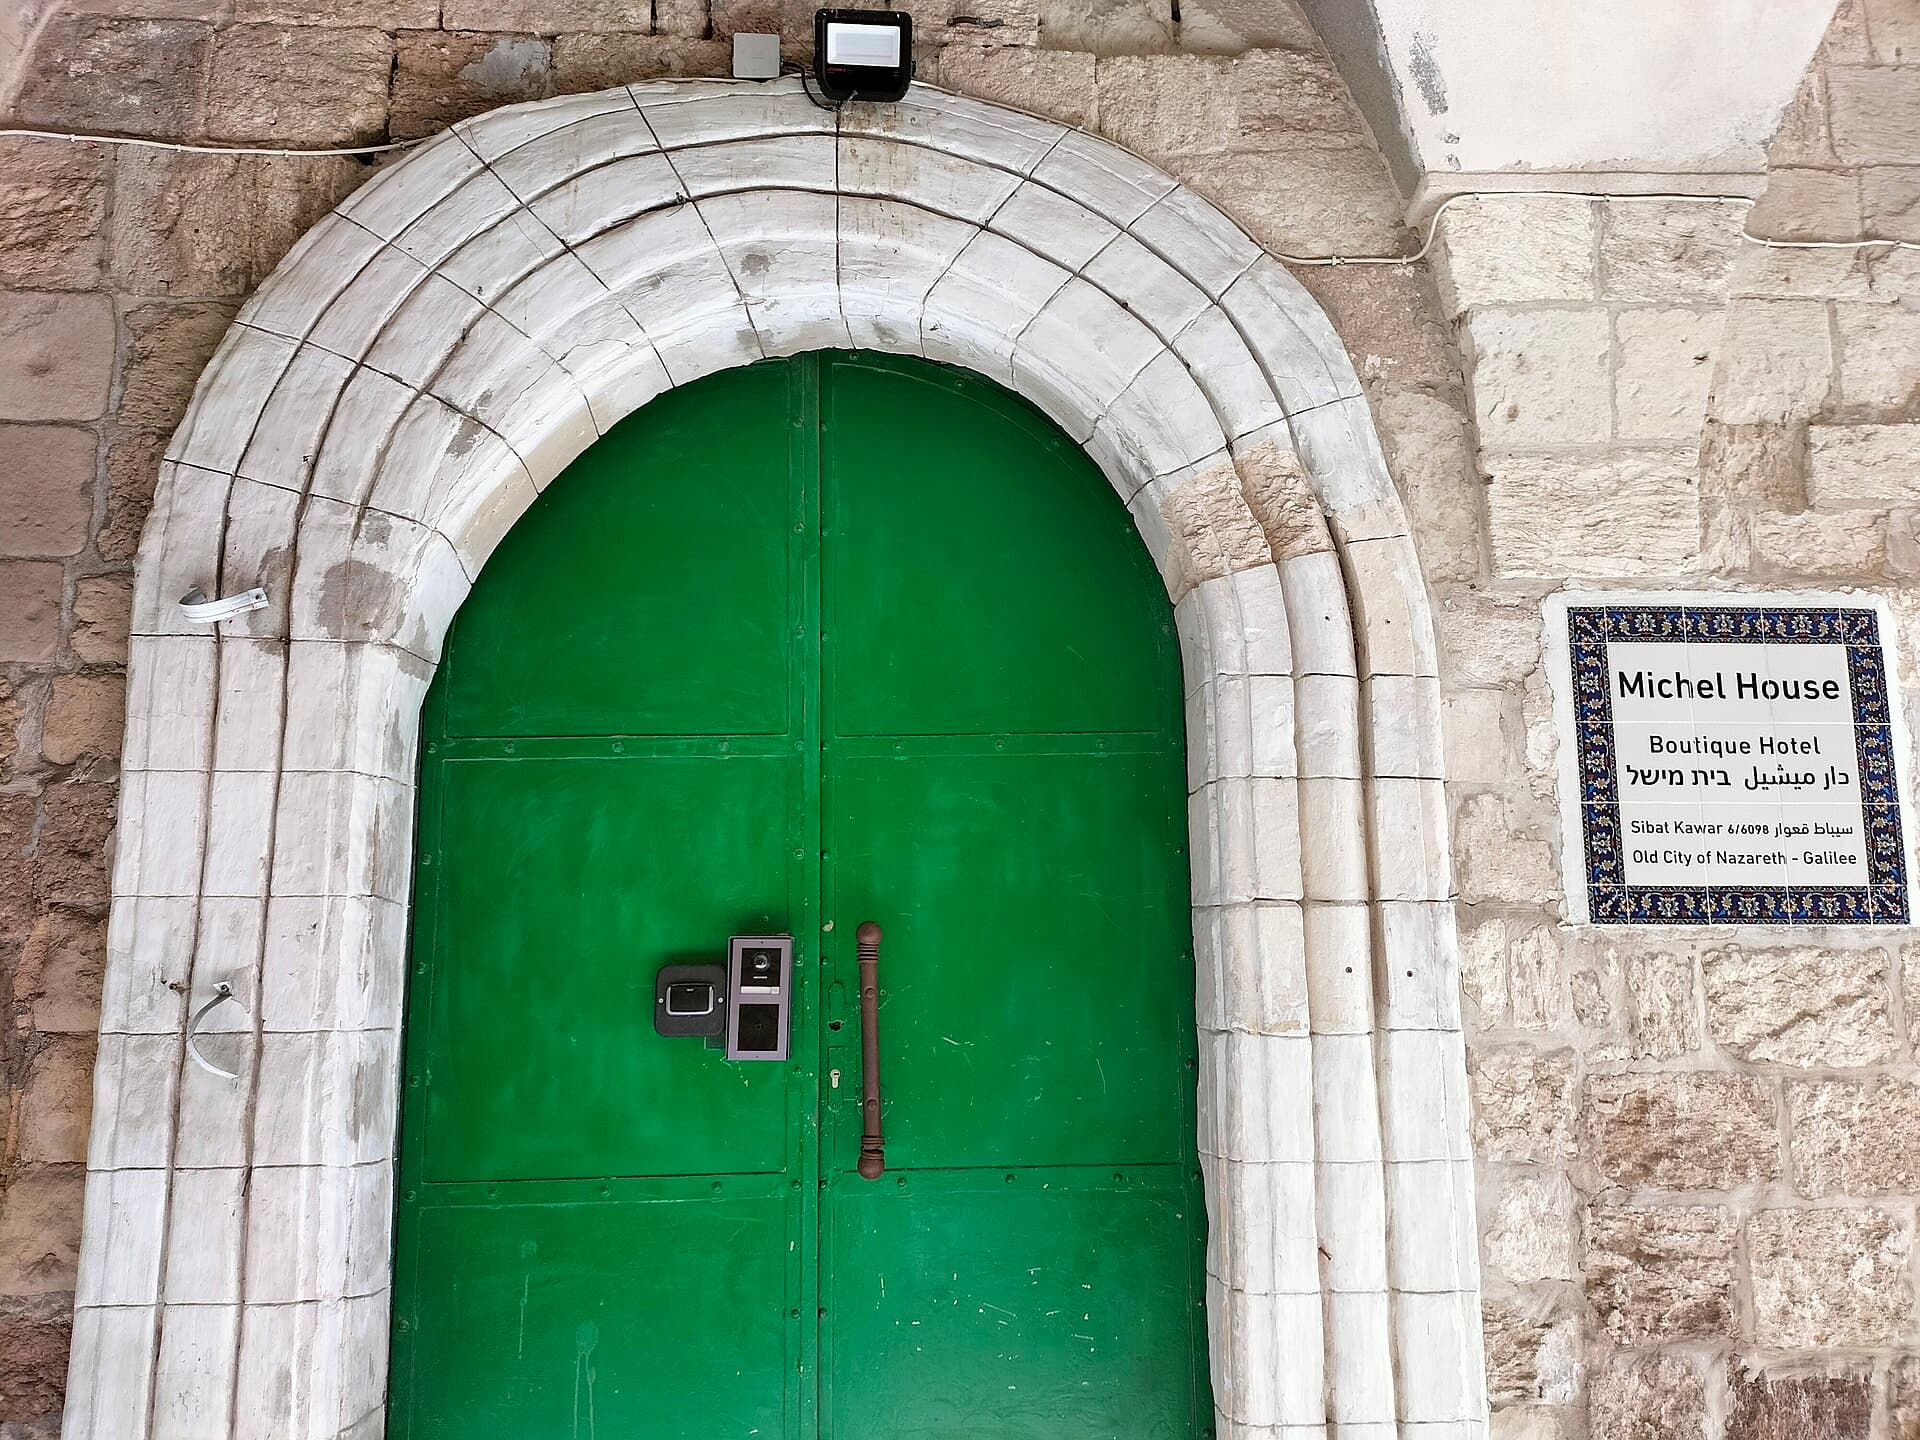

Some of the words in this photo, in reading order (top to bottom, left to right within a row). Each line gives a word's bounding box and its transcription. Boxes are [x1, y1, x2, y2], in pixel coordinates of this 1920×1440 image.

[1618, 671, 1726, 700] Michel
[1736, 673, 1840, 700] House
[1649, 735, 1751, 759] Boutique
[1759, 736, 1821, 755] Hotel
[1625, 764, 1684, 786] מישל
[1691, 767, 1732, 786] בית
[1744, 763, 1816, 791] ميشيل
[1823, 765, 1850, 791] دار
[1631, 820, 1671, 834] Sibat
[1673, 820, 1724, 835] Kawar
[1727, 823, 1770, 835] 6/6098
[1774, 822, 1810, 838] قعوار
[1813, 823, 1853, 838] سيباط
[1632, 849, 1659, 864] Old
[1663, 850, 1692, 867] City
[1696, 850, 1712, 864] of
[1716, 850, 1787, 865] Nazareth
[1803, 850, 1857, 865] Galilee
